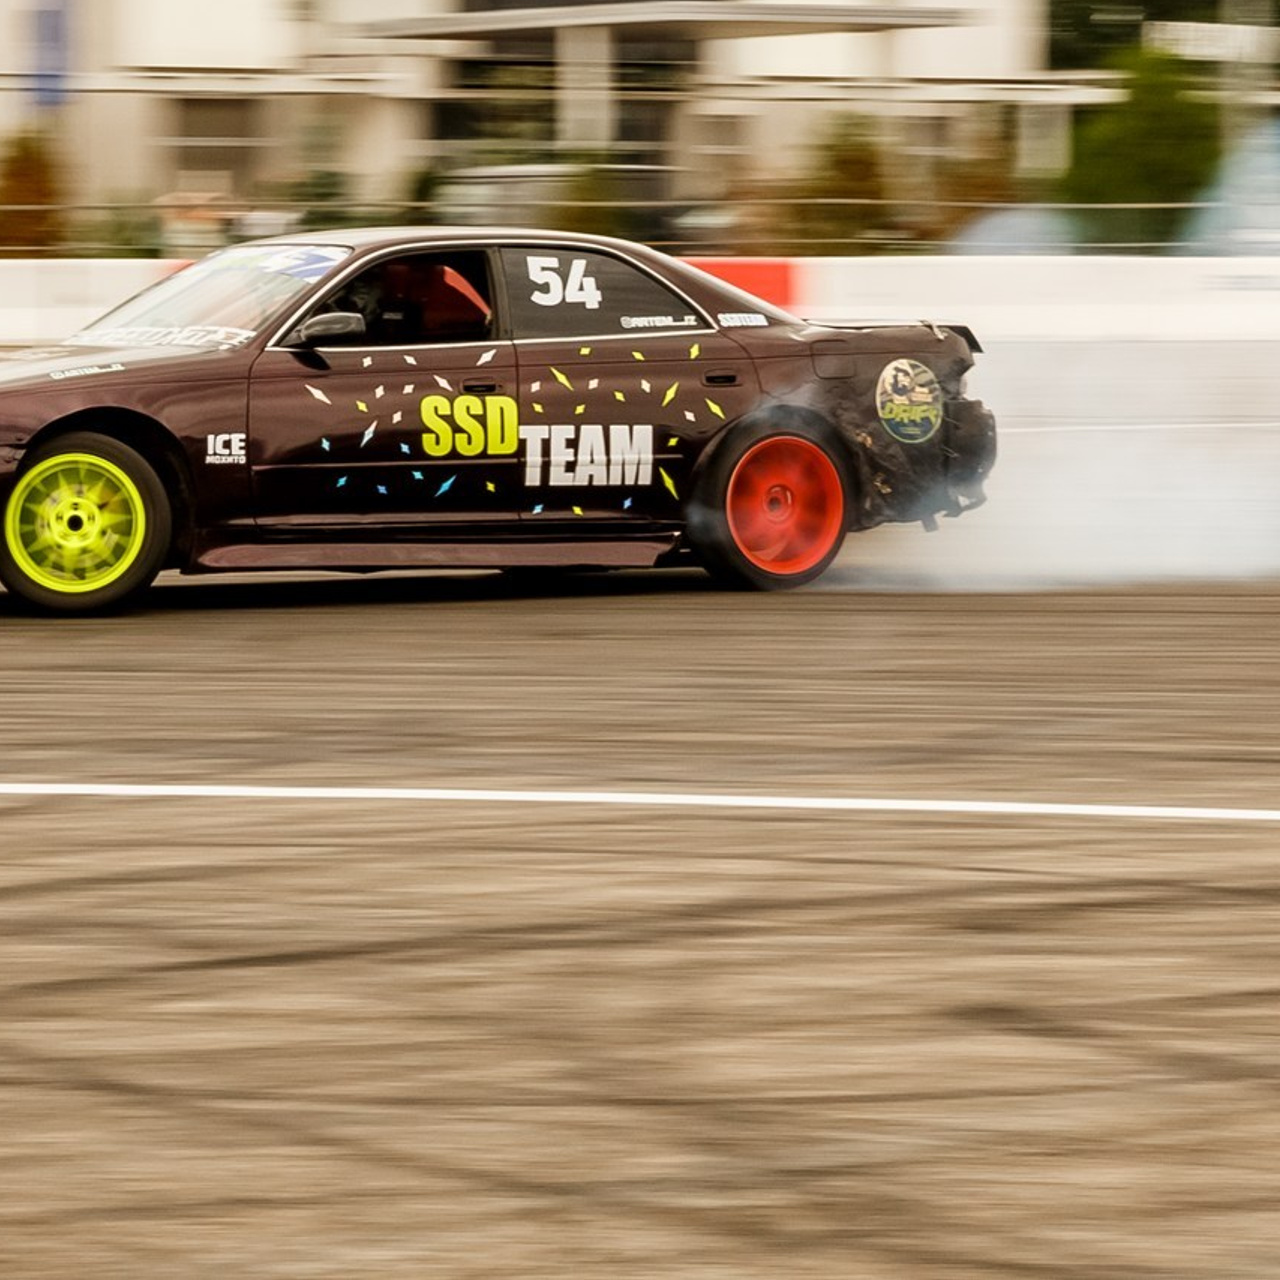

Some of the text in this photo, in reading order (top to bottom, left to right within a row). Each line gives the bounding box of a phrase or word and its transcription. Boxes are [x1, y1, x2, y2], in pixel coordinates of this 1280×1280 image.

[526, 255, 603, 309] 54
[207, 433, 246, 455] ICE
[420, 395, 653, 487] SSD TEAM
